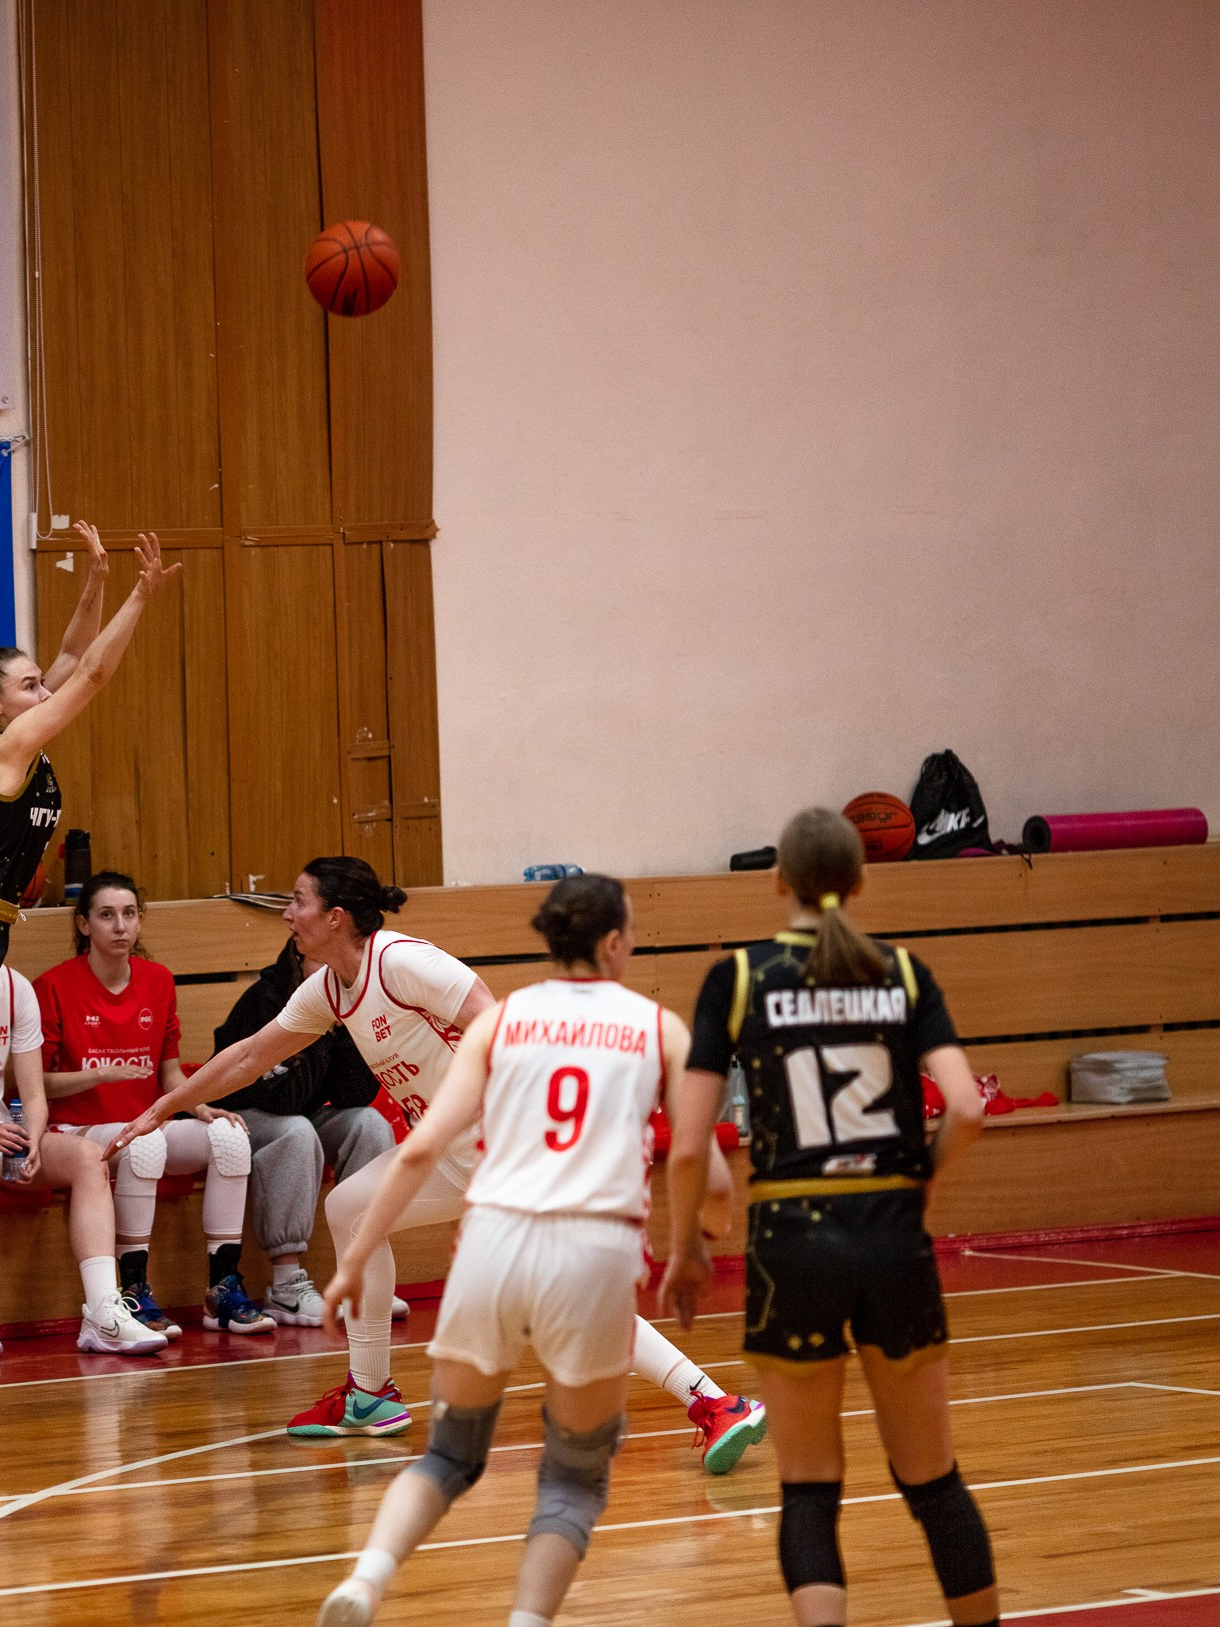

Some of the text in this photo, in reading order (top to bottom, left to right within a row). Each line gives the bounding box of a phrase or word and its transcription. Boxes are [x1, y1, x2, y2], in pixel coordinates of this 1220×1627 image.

[371, 1014, 388, 1031] FON
[765, 986, 908, 1028] СЕДЛЕЦКАЯ
[374, 1025, 392, 1043] BET
[503, 1015, 648, 1059] МИХАЙЛОВА
[544, 1065, 590, 1153] 9
[784, 1043, 901, 1150] 12
